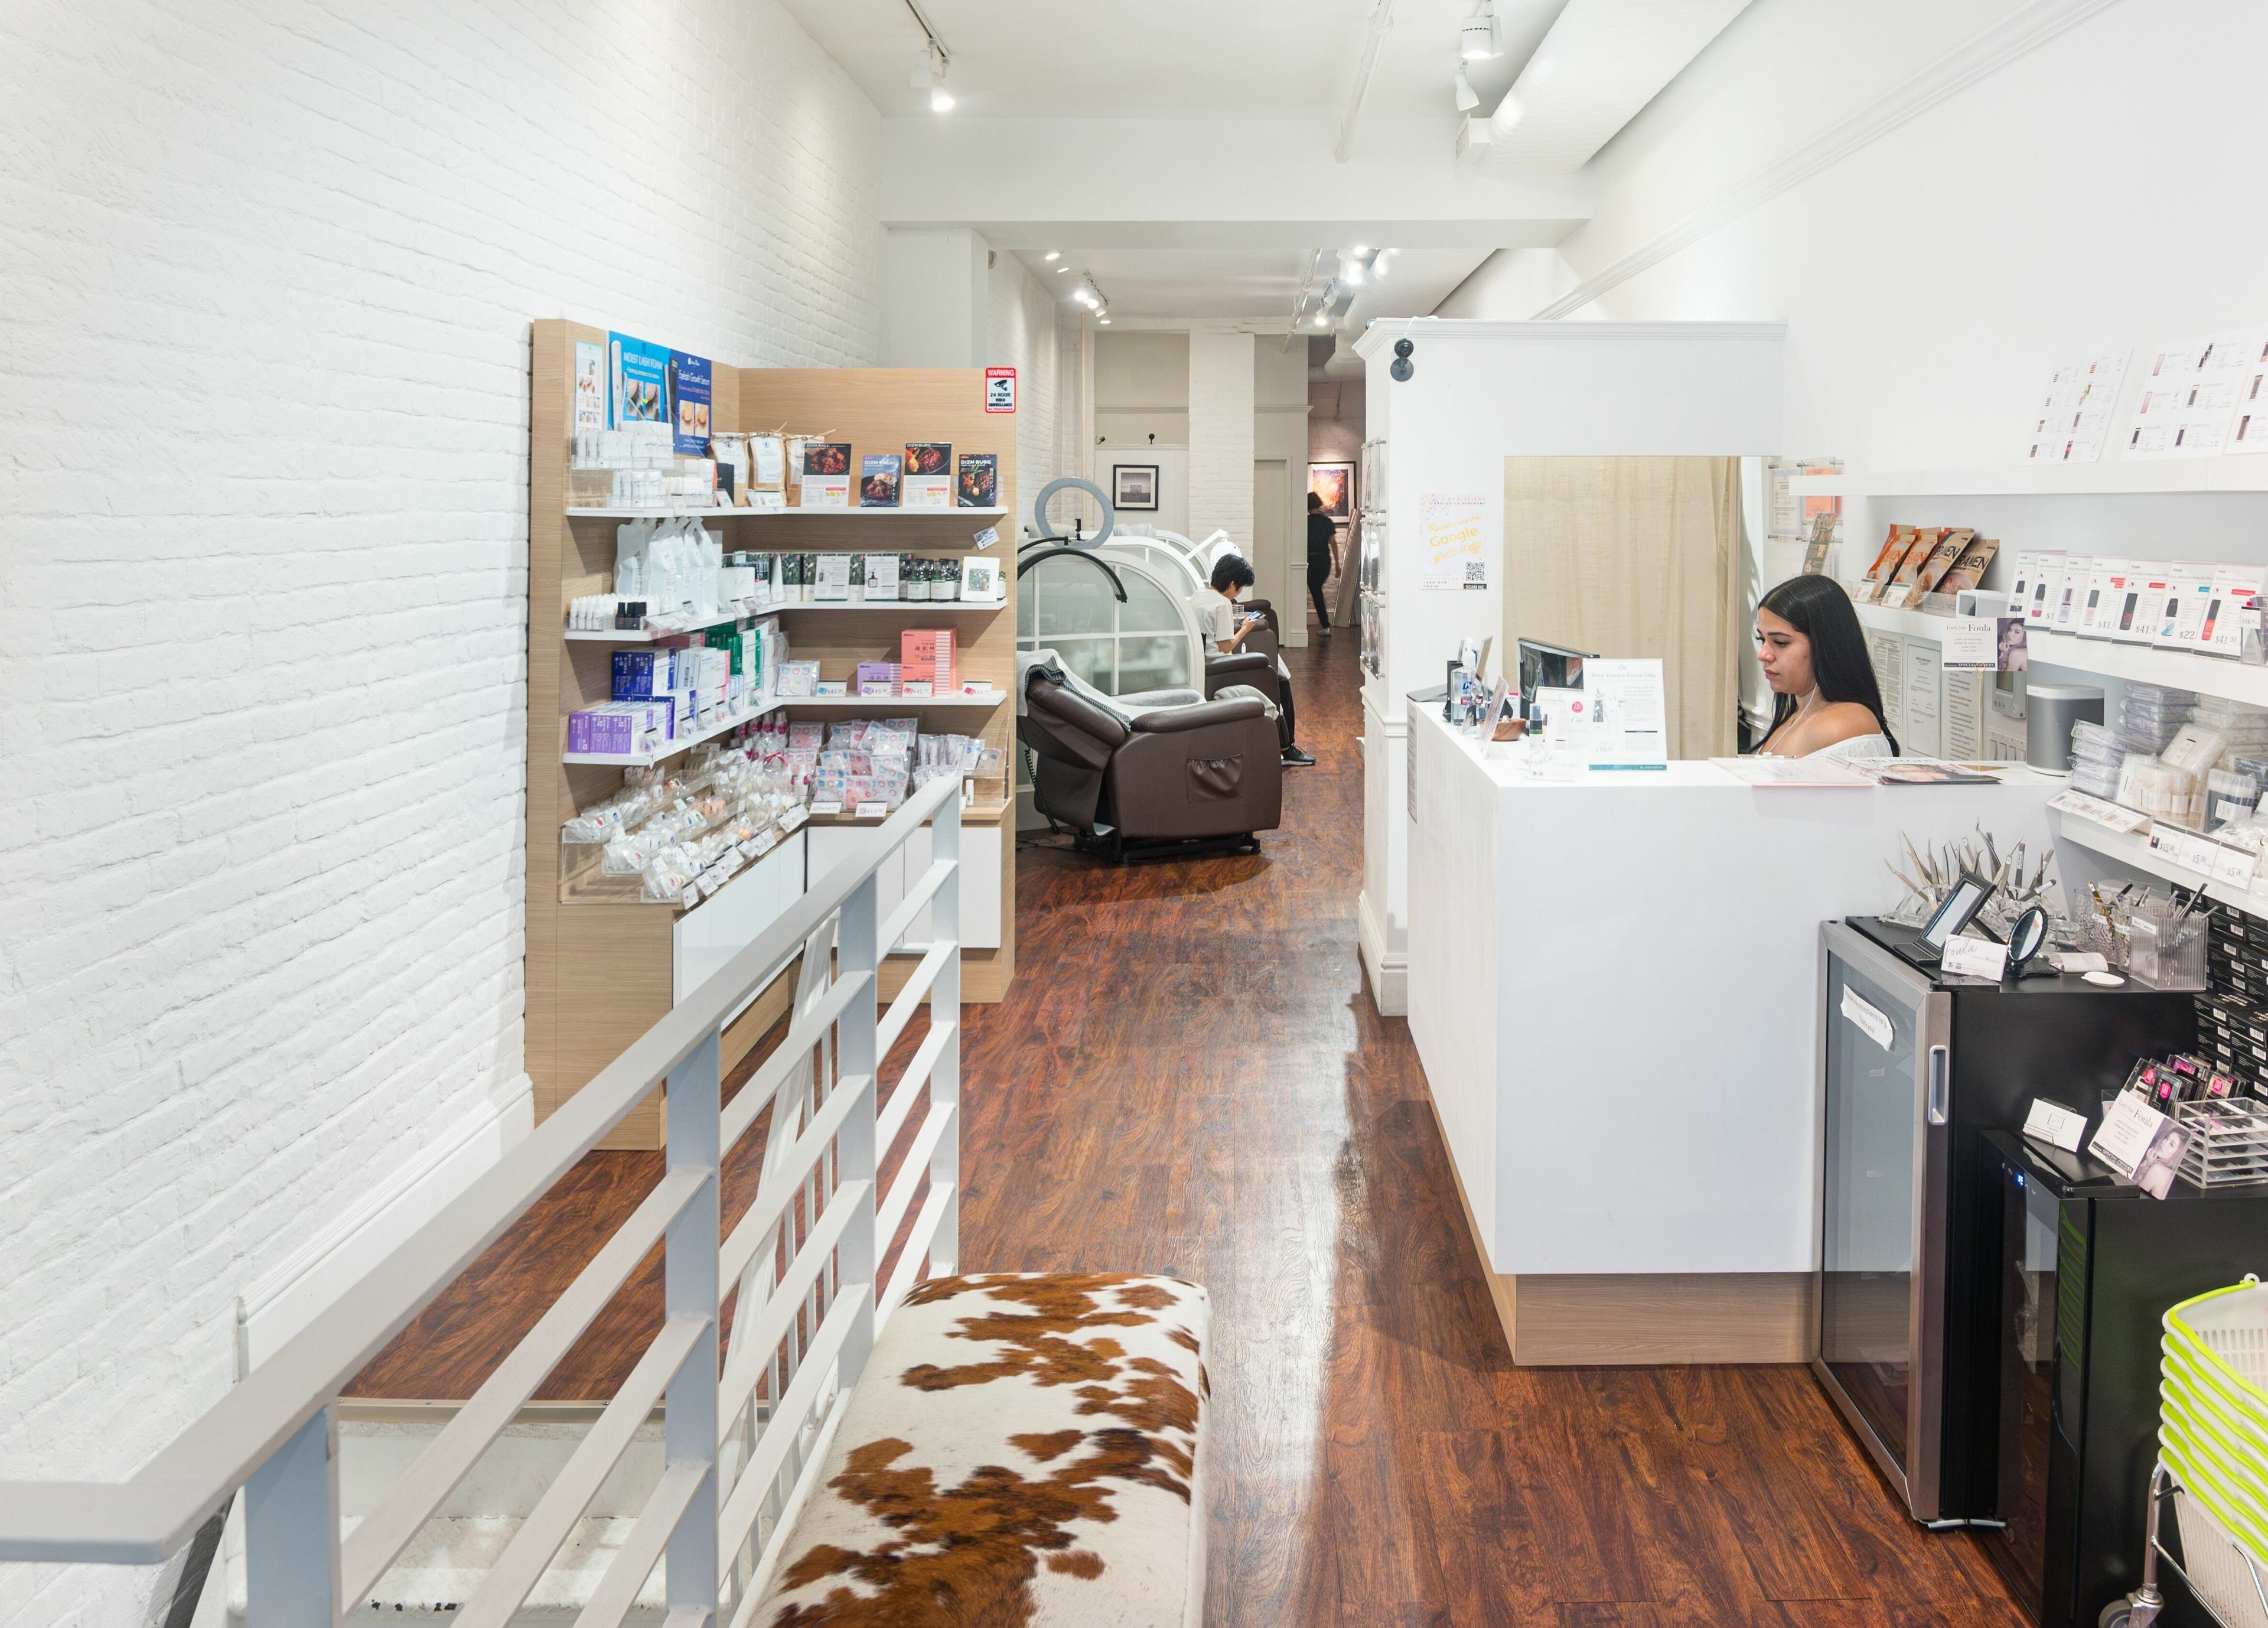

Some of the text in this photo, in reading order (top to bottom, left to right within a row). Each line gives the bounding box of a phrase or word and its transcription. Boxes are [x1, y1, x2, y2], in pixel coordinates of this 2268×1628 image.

[624, 352, 638, 364] MOIST
[638, 356, 650, 366] LASH
[1429, 528, 1478, 547] Google
[2133, 1109, 2153, 1129] Foula
